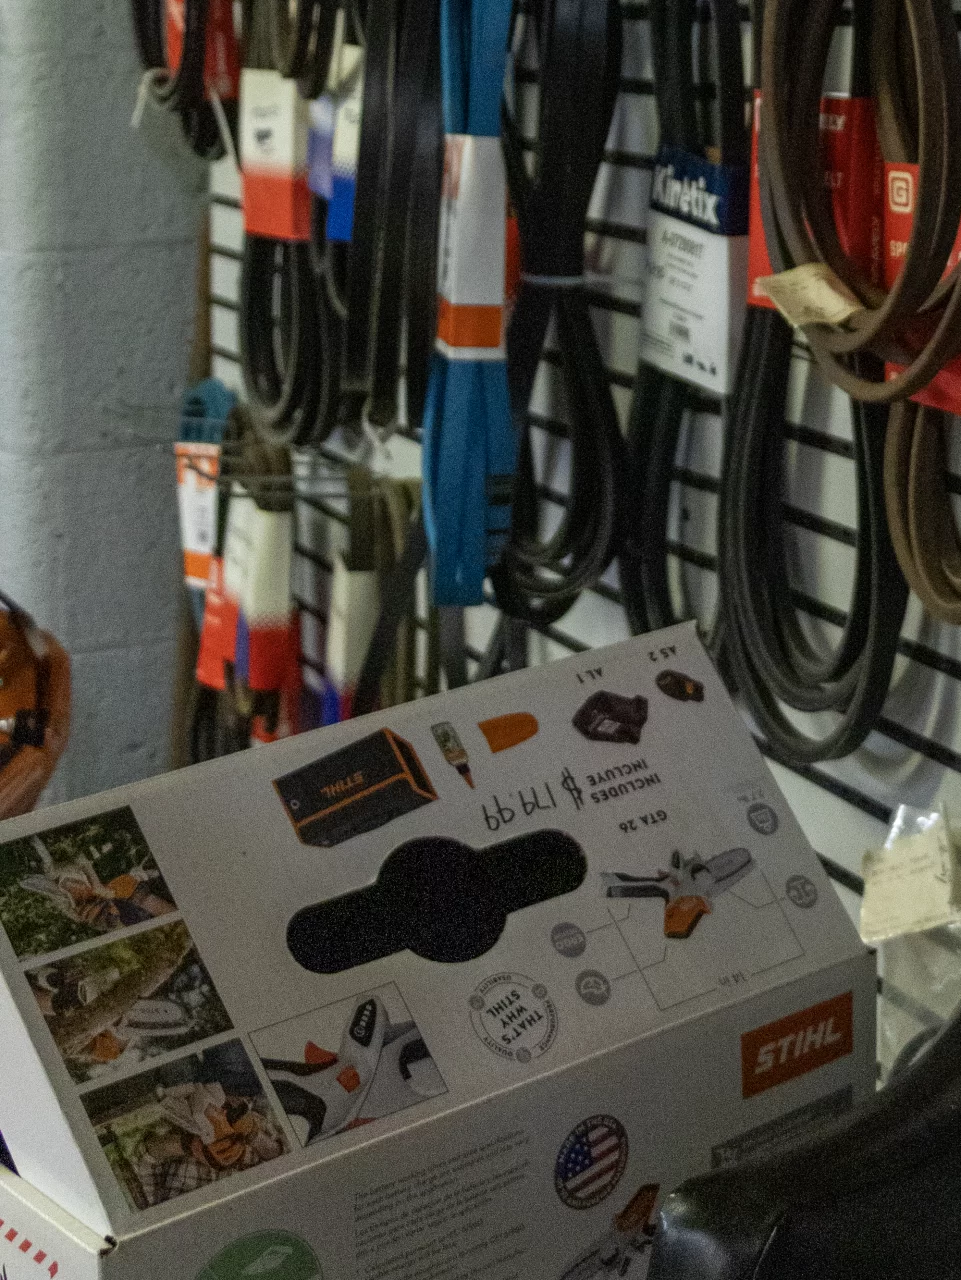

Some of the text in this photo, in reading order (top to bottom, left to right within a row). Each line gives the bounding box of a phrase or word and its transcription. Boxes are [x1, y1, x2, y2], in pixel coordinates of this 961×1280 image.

[652, 164, 718, 225] Kinetix
[586, 759, 649, 787] INCLUYE
[590, 773, 662, 804] INCLUDES
[618, 809, 668, 834] GTA 26
[486, 989, 521, 1018] STIHL
[499, 1004, 529, 1030] WHY
[501, 1010, 544, 1045] THAT'S
[754, 1017, 844, 1075] STIHL
